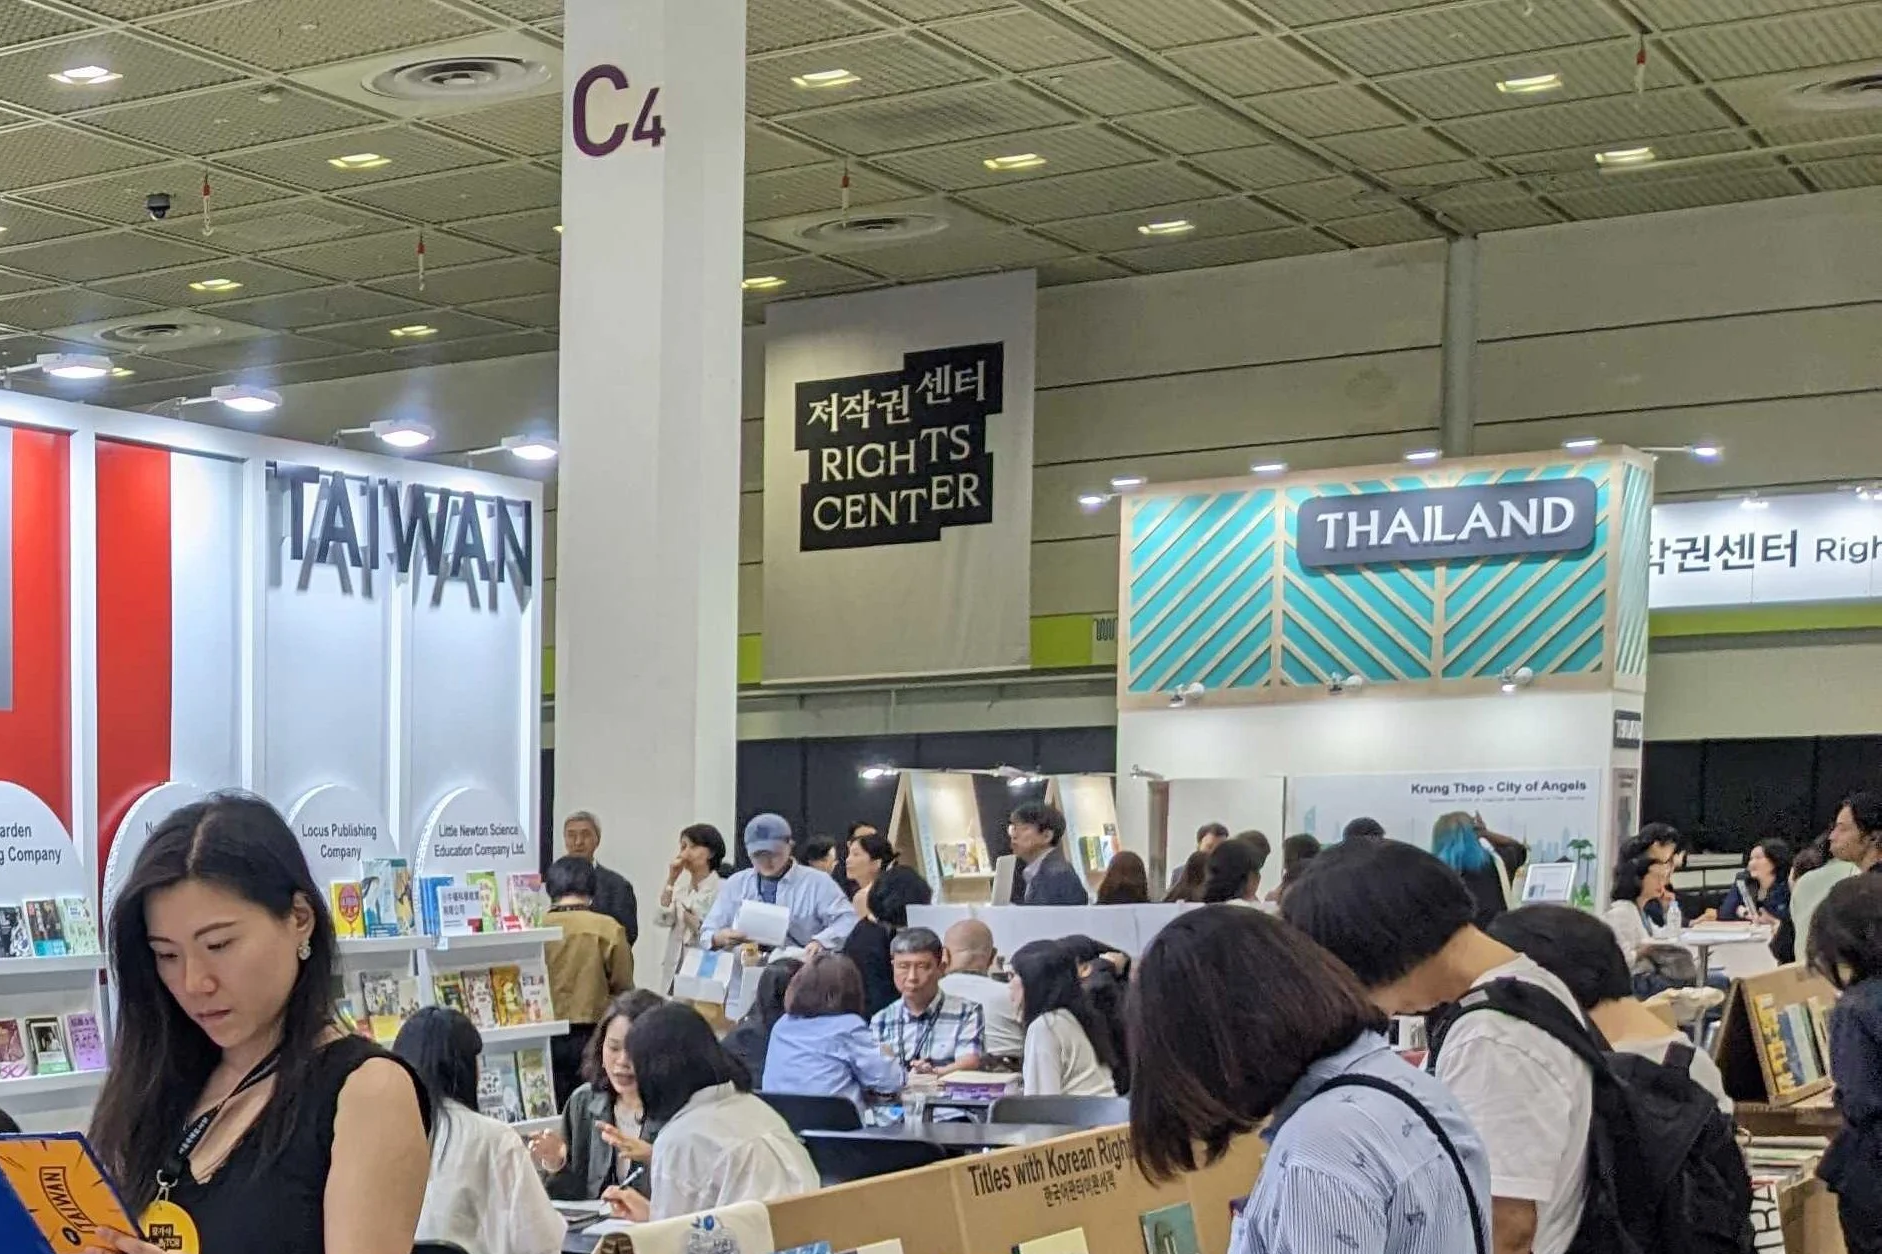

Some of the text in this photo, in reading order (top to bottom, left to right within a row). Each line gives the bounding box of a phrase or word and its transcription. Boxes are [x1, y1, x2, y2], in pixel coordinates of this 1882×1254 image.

[572, 64, 666, 158] C4
[821, 424, 971, 482] RIGHTS
[270, 460, 532, 586] TAIWAN
[813, 473, 982, 531] CENTER
[1317, 496, 1575, 550] THAILAND
[1411, 783, 1449, 796] Krung
[1454, 782, 1485, 795] Thep
[1496, 781, 1521, 794] City
[1525, 780, 1538, 792] of
[1541, 780, 1586, 793] Angels
[8, 846, 62, 864] Company
[302, 823, 377, 840] Locus Publishing
[321, 845, 362, 861] Company
[434, 843, 525, 860] Education Company Ltd.
[439, 822, 518, 837] Little Newton Science
[968, 1163, 1012, 1197] Titles
[1014, 1154, 1045, 1184] with
[1046, 1146, 1097, 1178] Korean
[43, 1172, 95, 1230] TAIWAN
